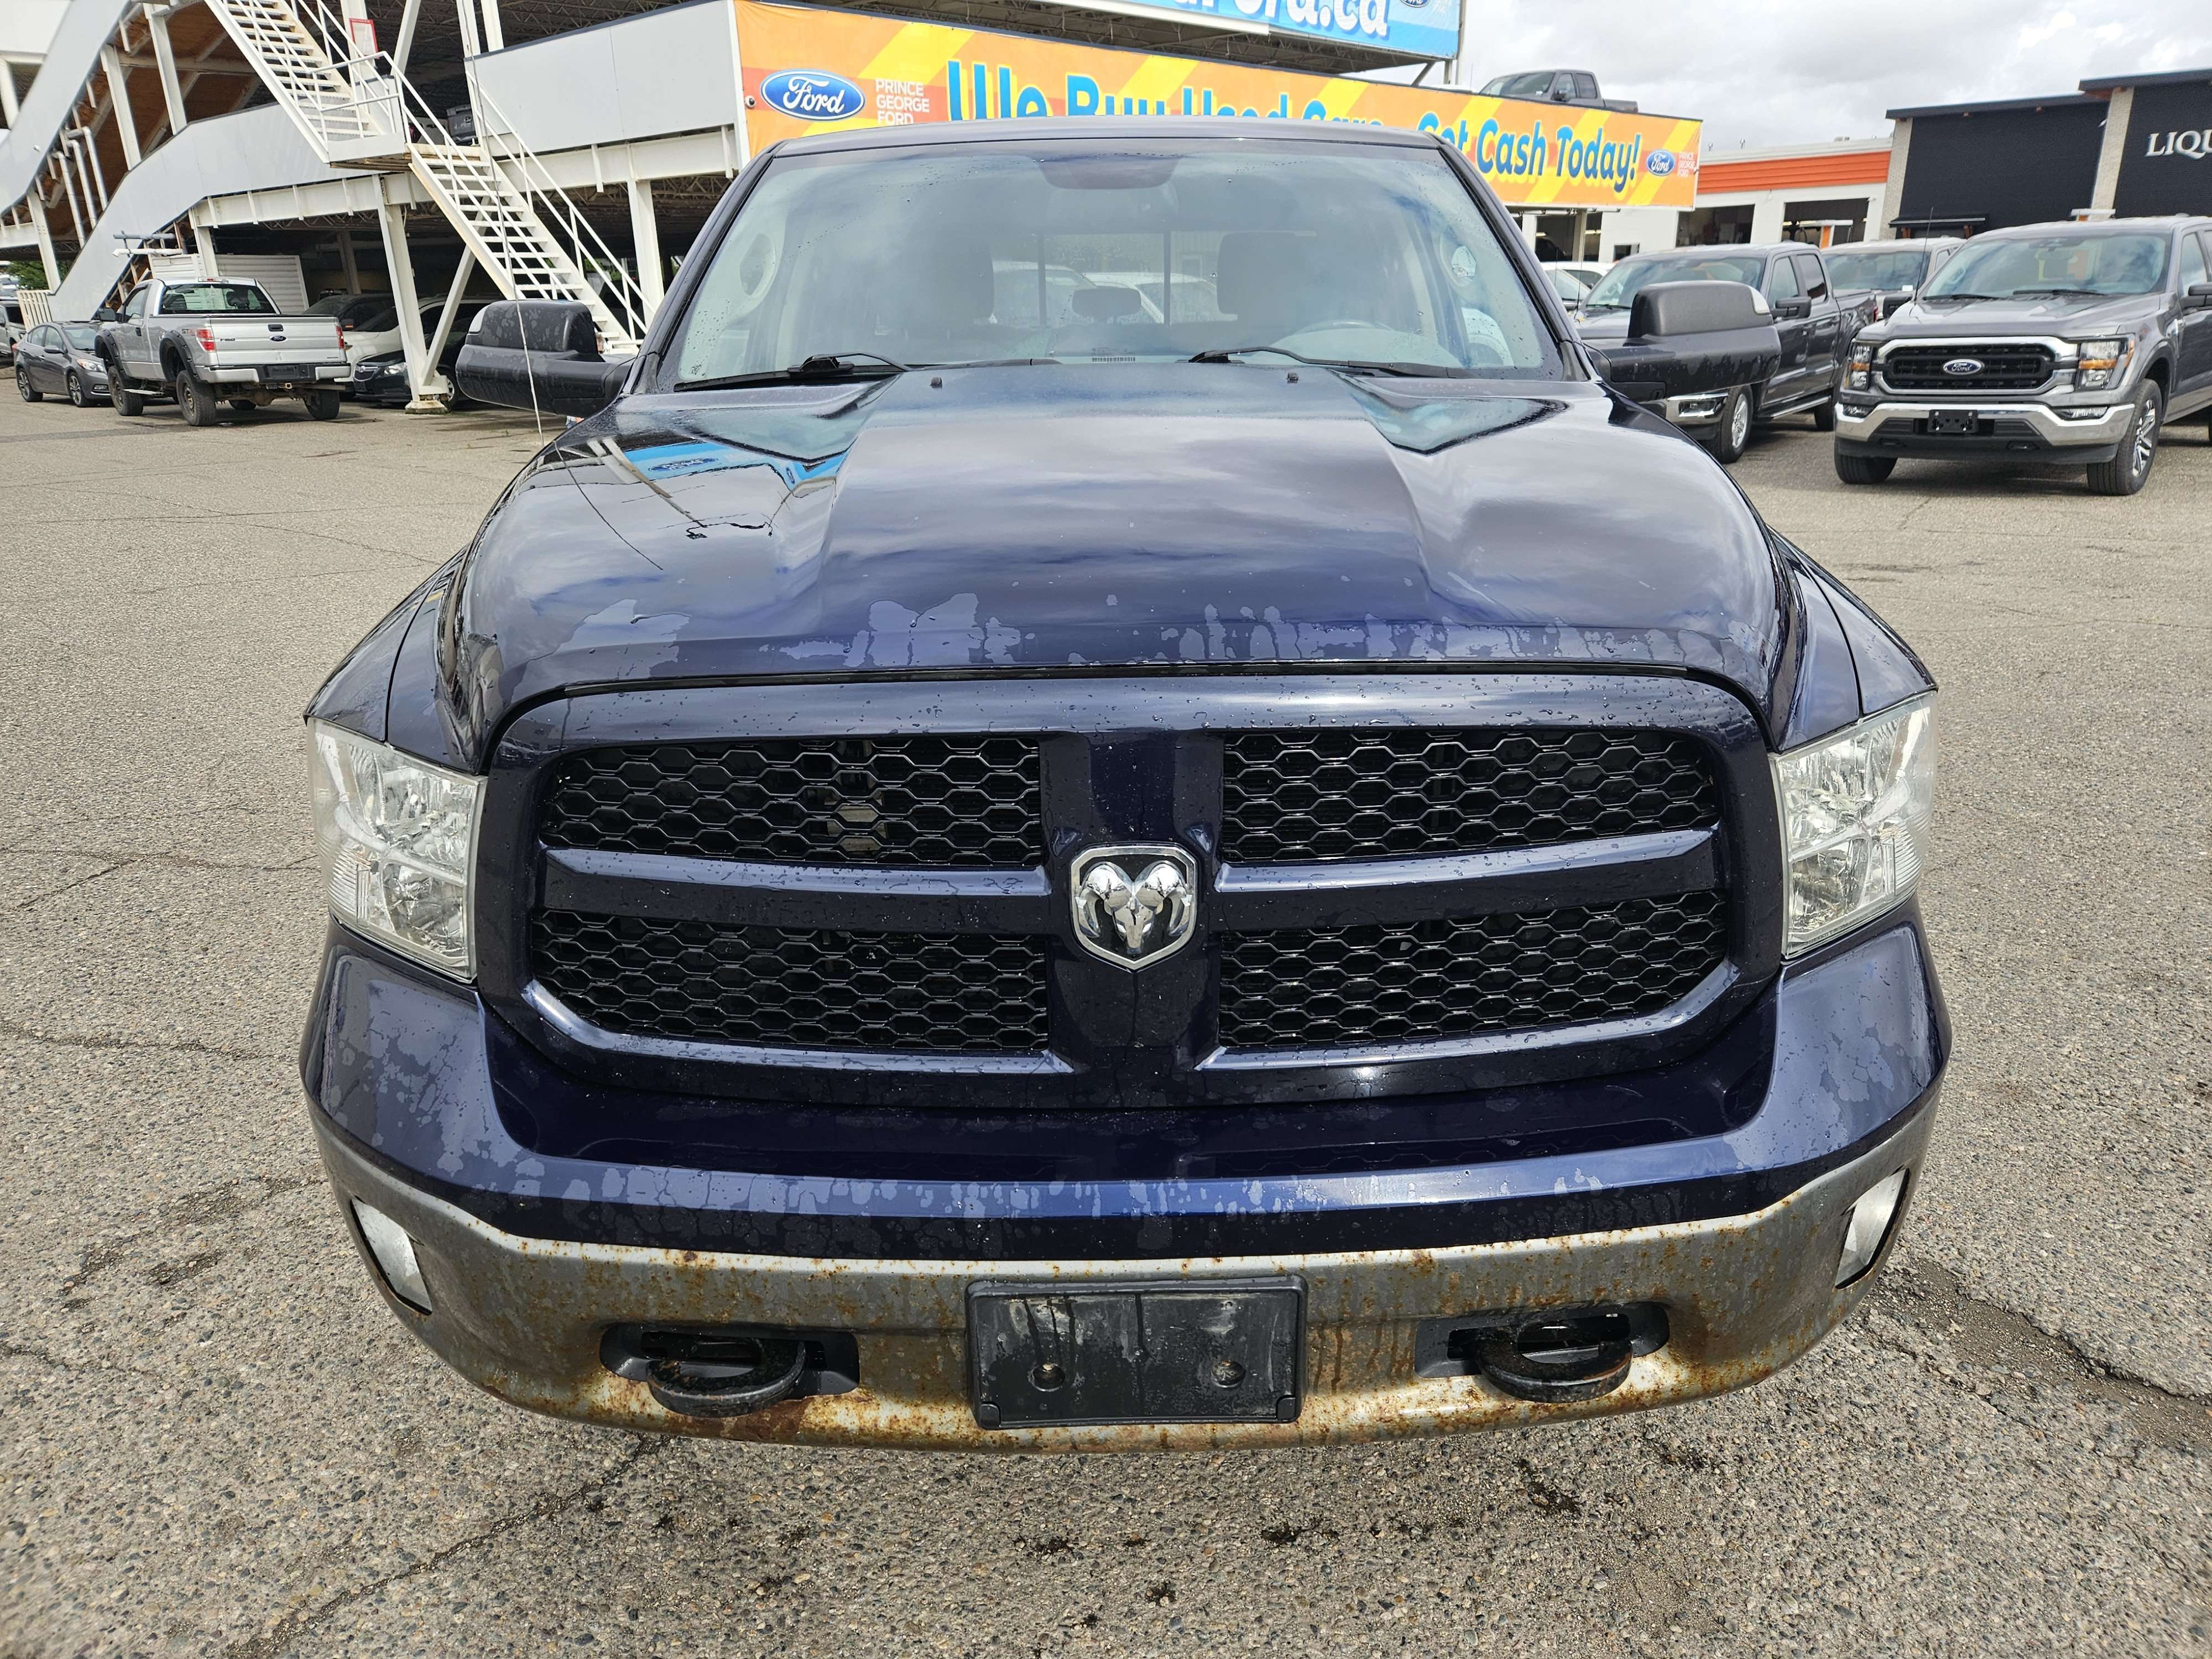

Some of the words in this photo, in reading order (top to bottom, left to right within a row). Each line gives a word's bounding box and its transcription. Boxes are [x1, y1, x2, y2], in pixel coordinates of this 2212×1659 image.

[782, 76, 846, 114] Ford
[875, 78, 924, 97] PRINCE
[876, 94, 930, 113] GEORGE
[877, 110, 914, 126] FORD
[1477, 118, 1547, 176] Cash
[1556, 126, 1642, 193] Today!
[1651, 153, 1670, 173] Ford
[1952, 362, 1973, 372] Ford
